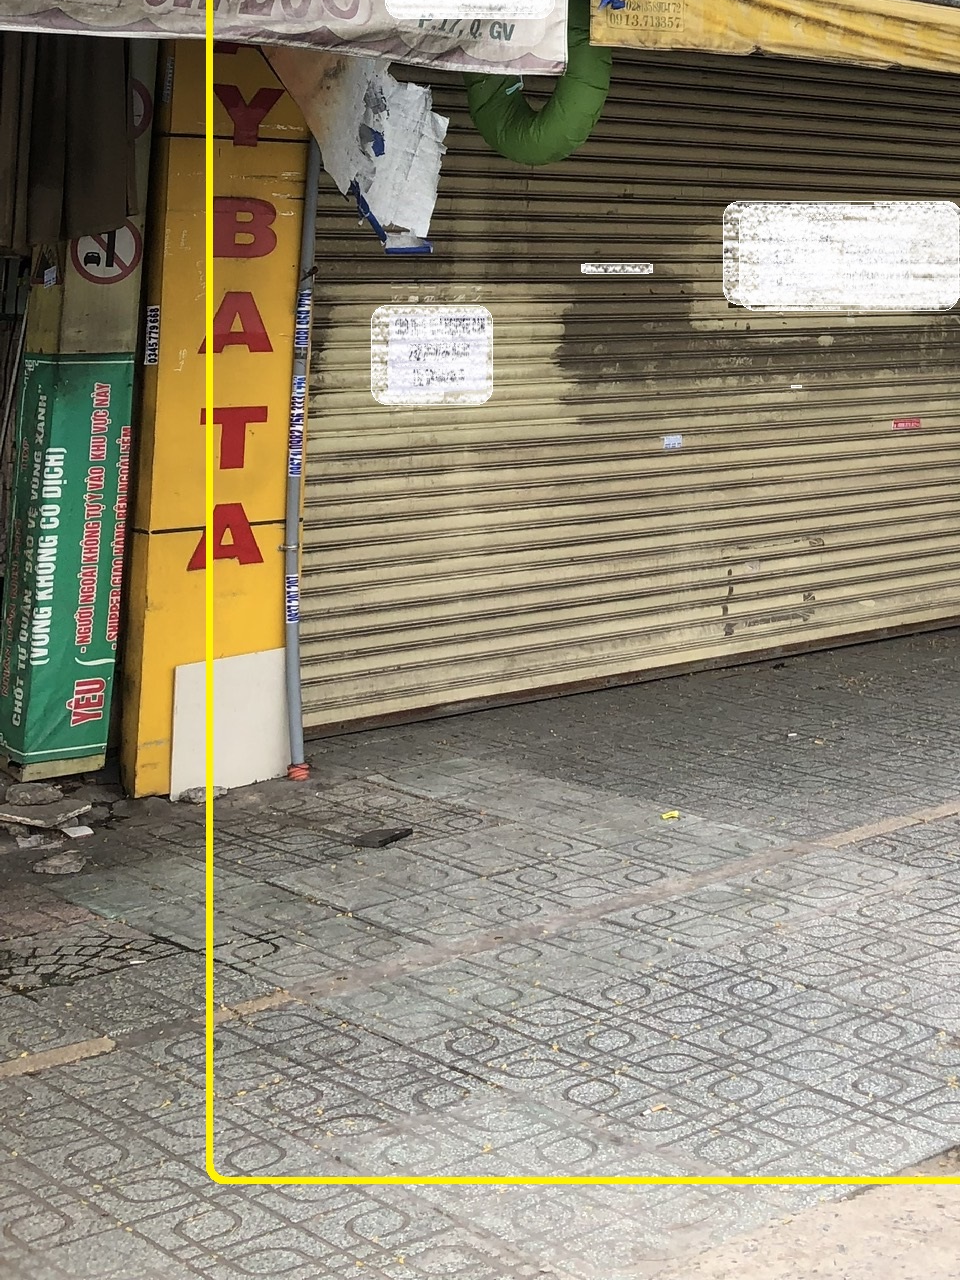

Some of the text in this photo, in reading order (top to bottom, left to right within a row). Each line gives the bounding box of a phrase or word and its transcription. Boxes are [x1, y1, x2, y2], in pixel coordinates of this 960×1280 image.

[489, 21, 516, 41] GV
[90, 381, 111, 408] NÀY
[90, 408, 112, 435] VỰC
[88, 434, 109, 462] KHU
[84, 465, 105, 492] VÀO
[39, 503, 61, 531] CÓ
[79, 519, 102, 564] KHÔNG
[35, 534, 59, 601] KHÔNG
[11, 674, 25, 728] CHỐT
[30, 450, 42, 501] VÙNG
[78, 564, 98, 604] NGOÀI
[66, 676, 107, 727] YÊU
